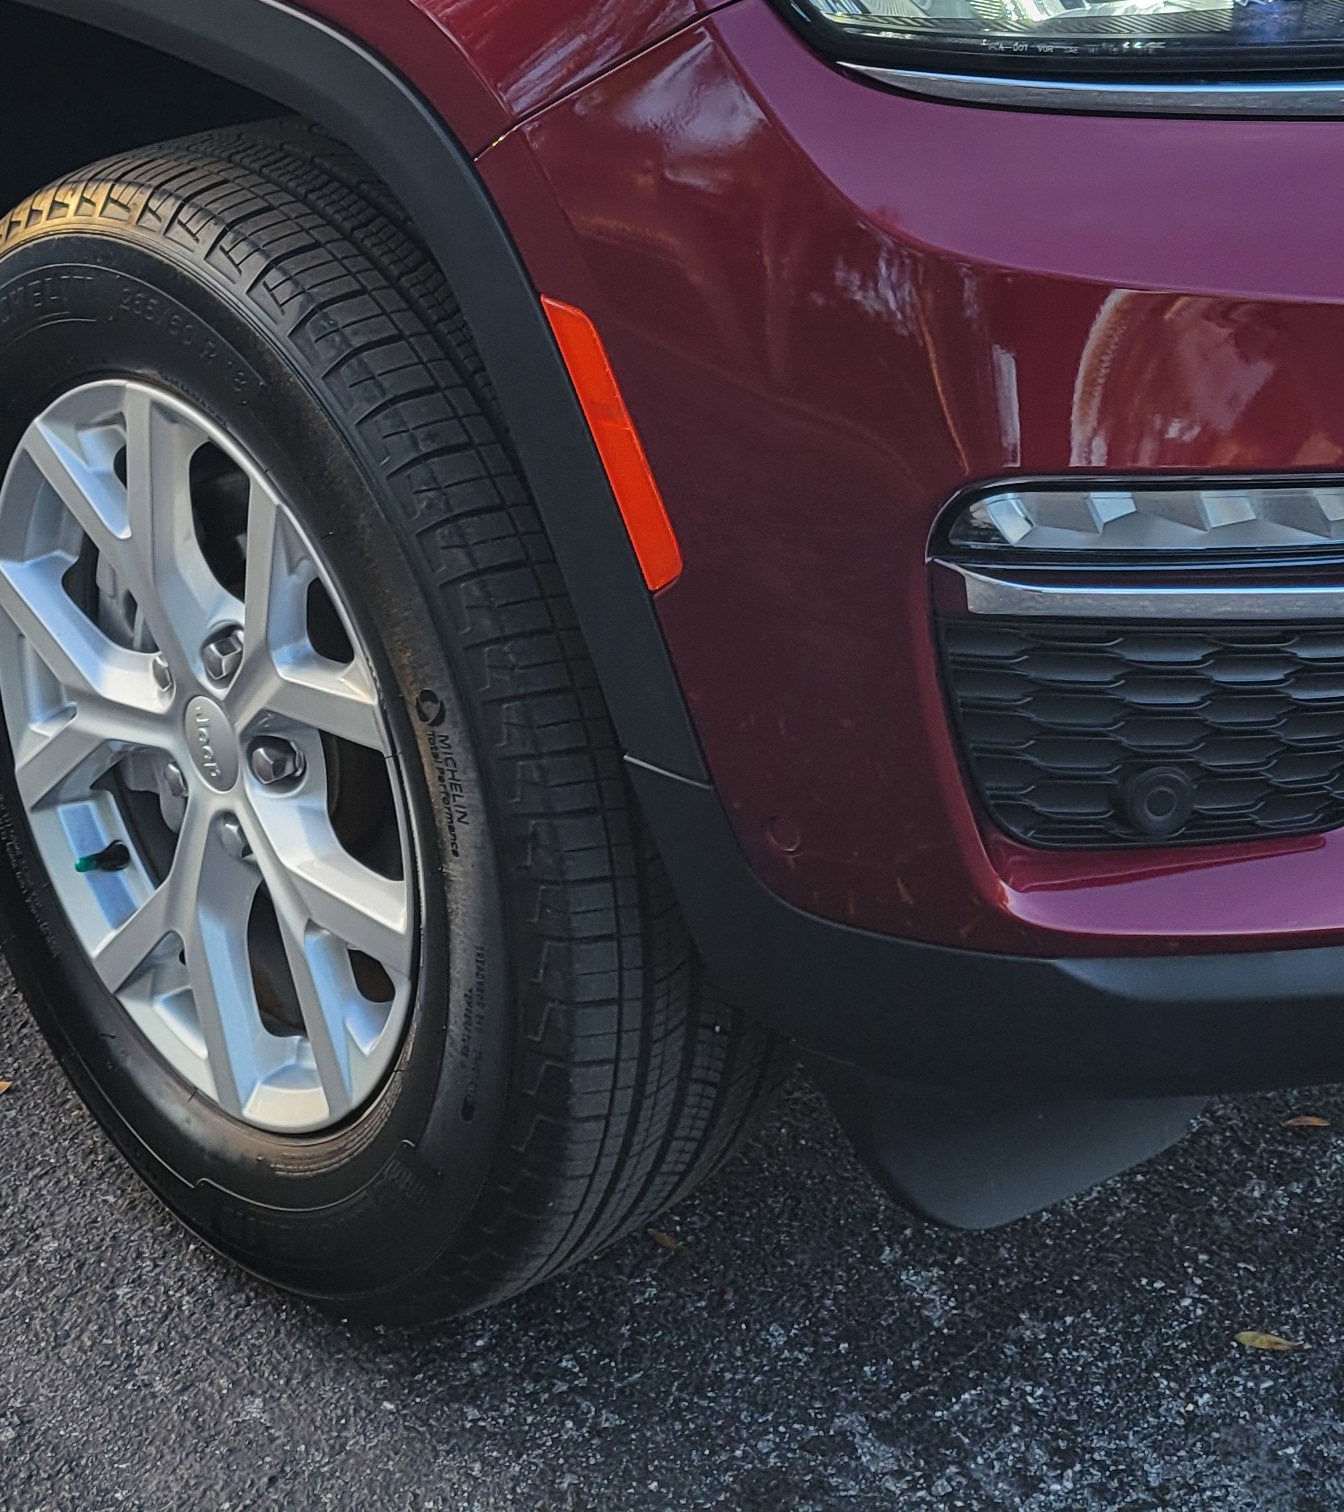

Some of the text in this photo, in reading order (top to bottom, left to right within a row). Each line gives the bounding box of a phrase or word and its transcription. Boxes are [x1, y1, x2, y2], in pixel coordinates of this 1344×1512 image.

[195, 706, 222, 778] Jeep
[438, 734, 469, 825] MICHELIN
[427, 731, 460, 858] Total Performance
